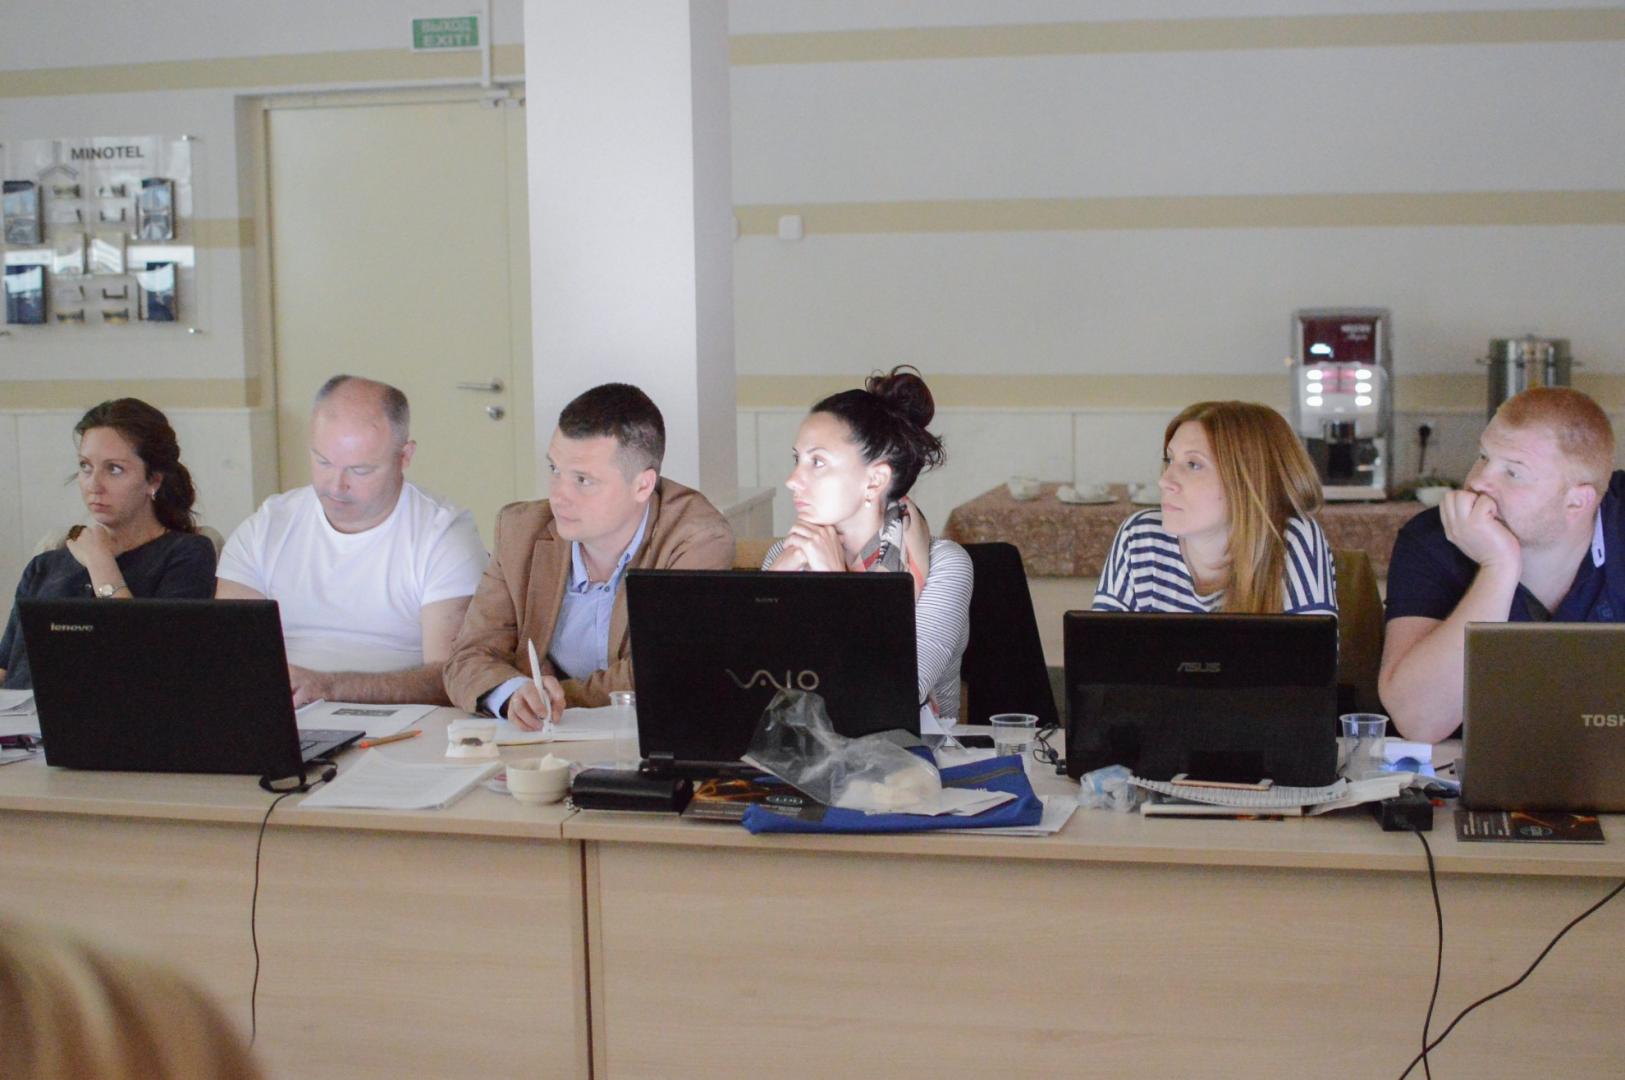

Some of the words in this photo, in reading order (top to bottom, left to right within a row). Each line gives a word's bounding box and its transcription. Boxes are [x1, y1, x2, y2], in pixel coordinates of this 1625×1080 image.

[71, 146, 144, 160] MINOTEL
[50, 622, 94, 631] lenovo
[1176, 662, 1221, 672] ASUS
[724, 668, 820, 693] VAIO
